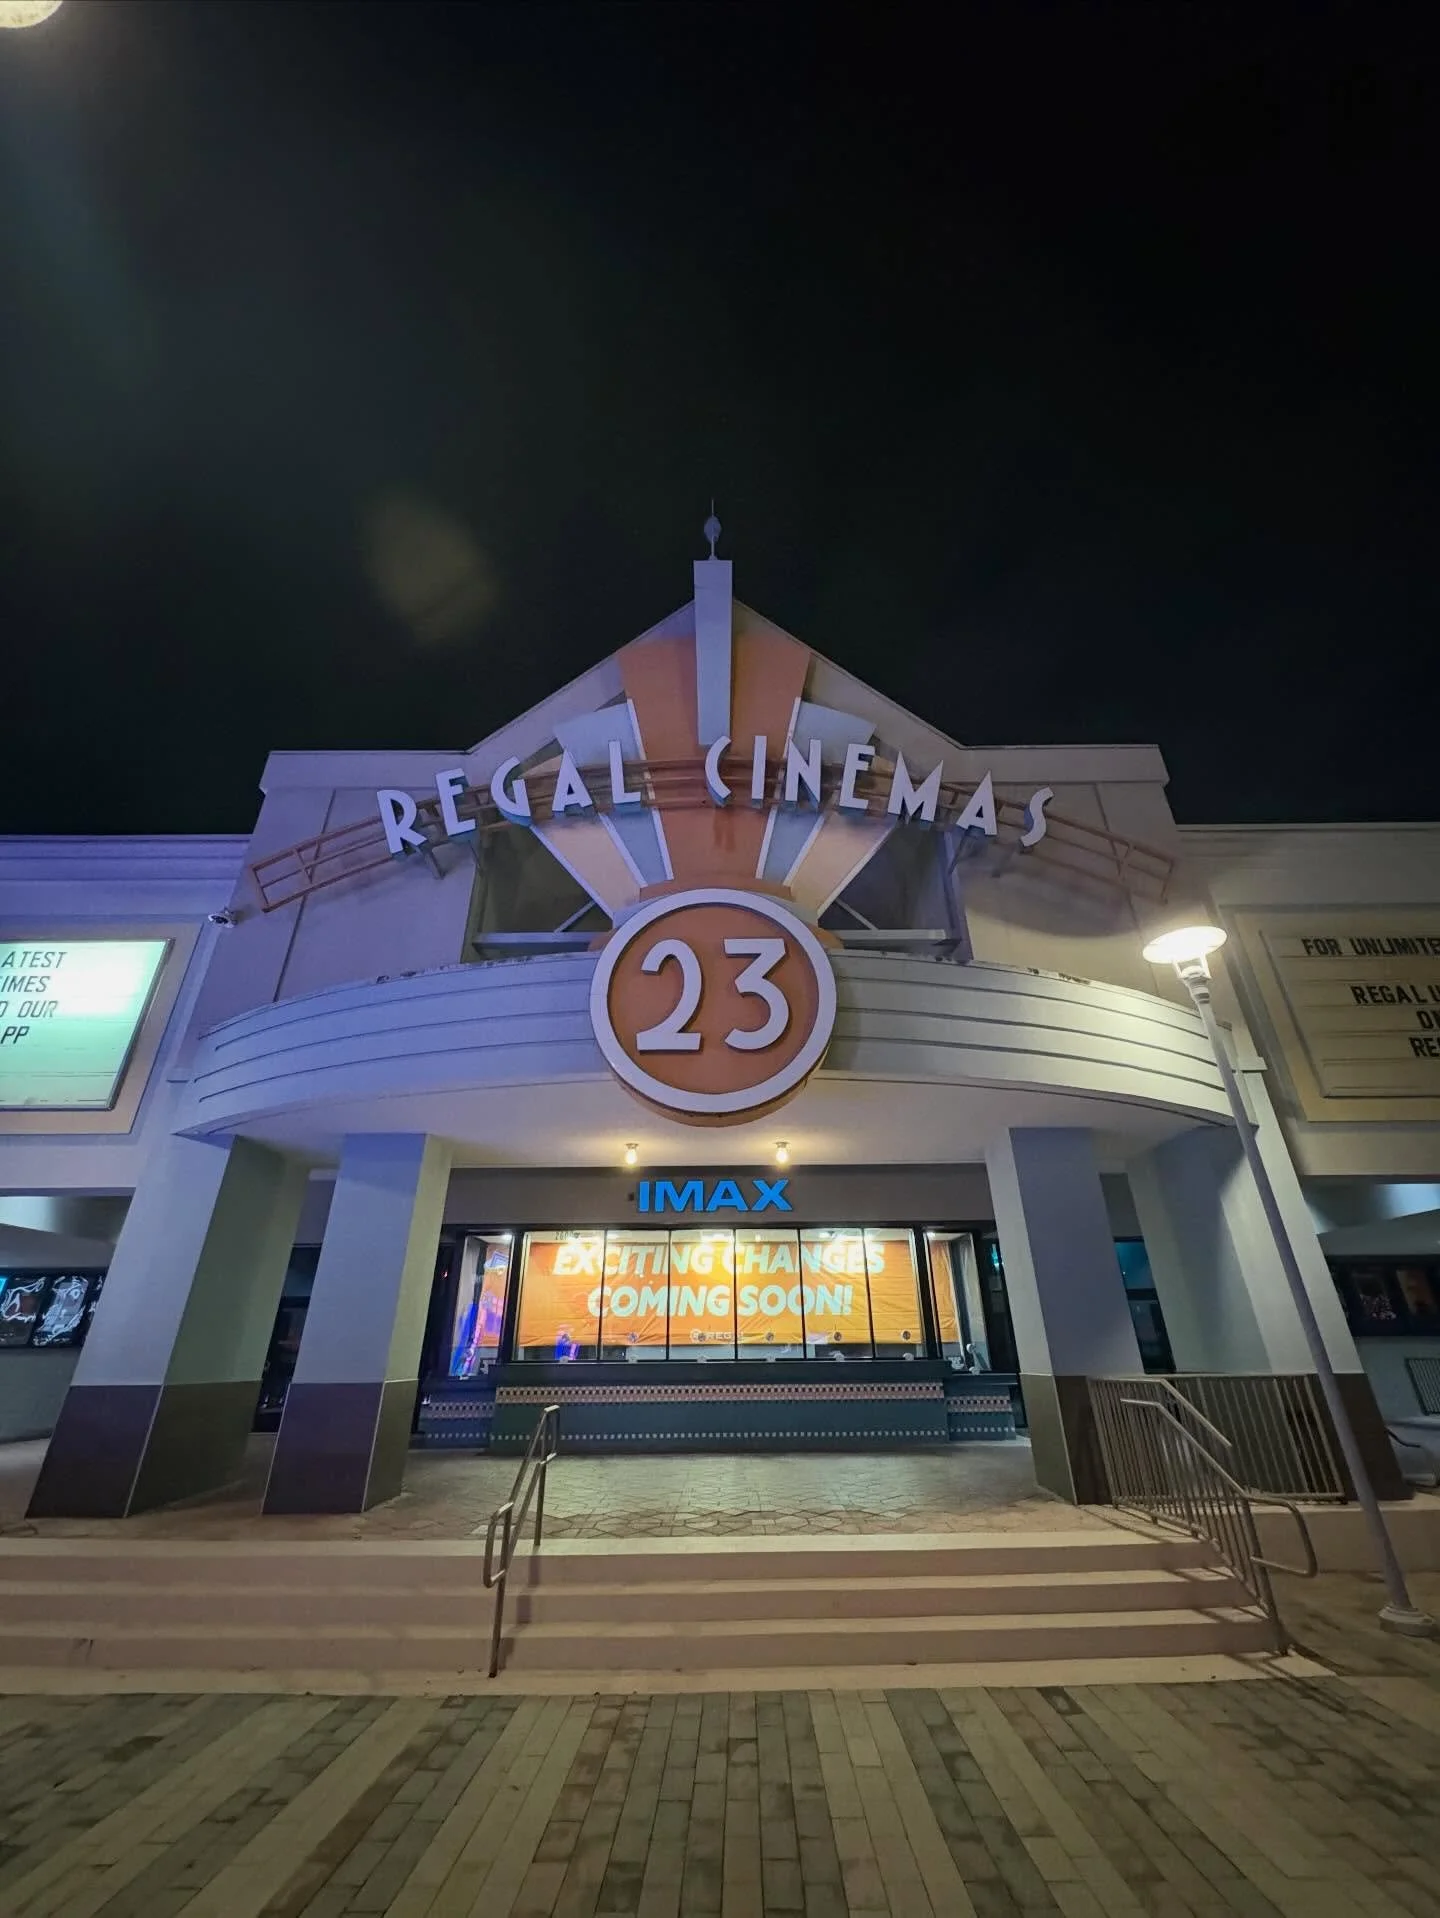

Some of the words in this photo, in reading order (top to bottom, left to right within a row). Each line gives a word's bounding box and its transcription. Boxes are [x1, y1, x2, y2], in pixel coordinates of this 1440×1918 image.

[377, 740, 642, 855] REGAL
[704, 735, 1055, 848] CINEMAS
[1301, 938, 1343, 956] FOR
[0, 975, 50, 993] IMES
[636, 938, 790, 1051] 23
[1351, 984, 1428, 1004] REGAL
[17, 1000, 58, 1018] OUR
[1408, 1036, 1440, 1058] RE
[637, 1178, 793, 1214] IMAX
[552, 1244, 714, 1276] EXCITING
[721, 1242, 885, 1275] CHANGES
[587, 1285, 731, 1318] COMING
[737, 1284, 854, 1317] SOON!
